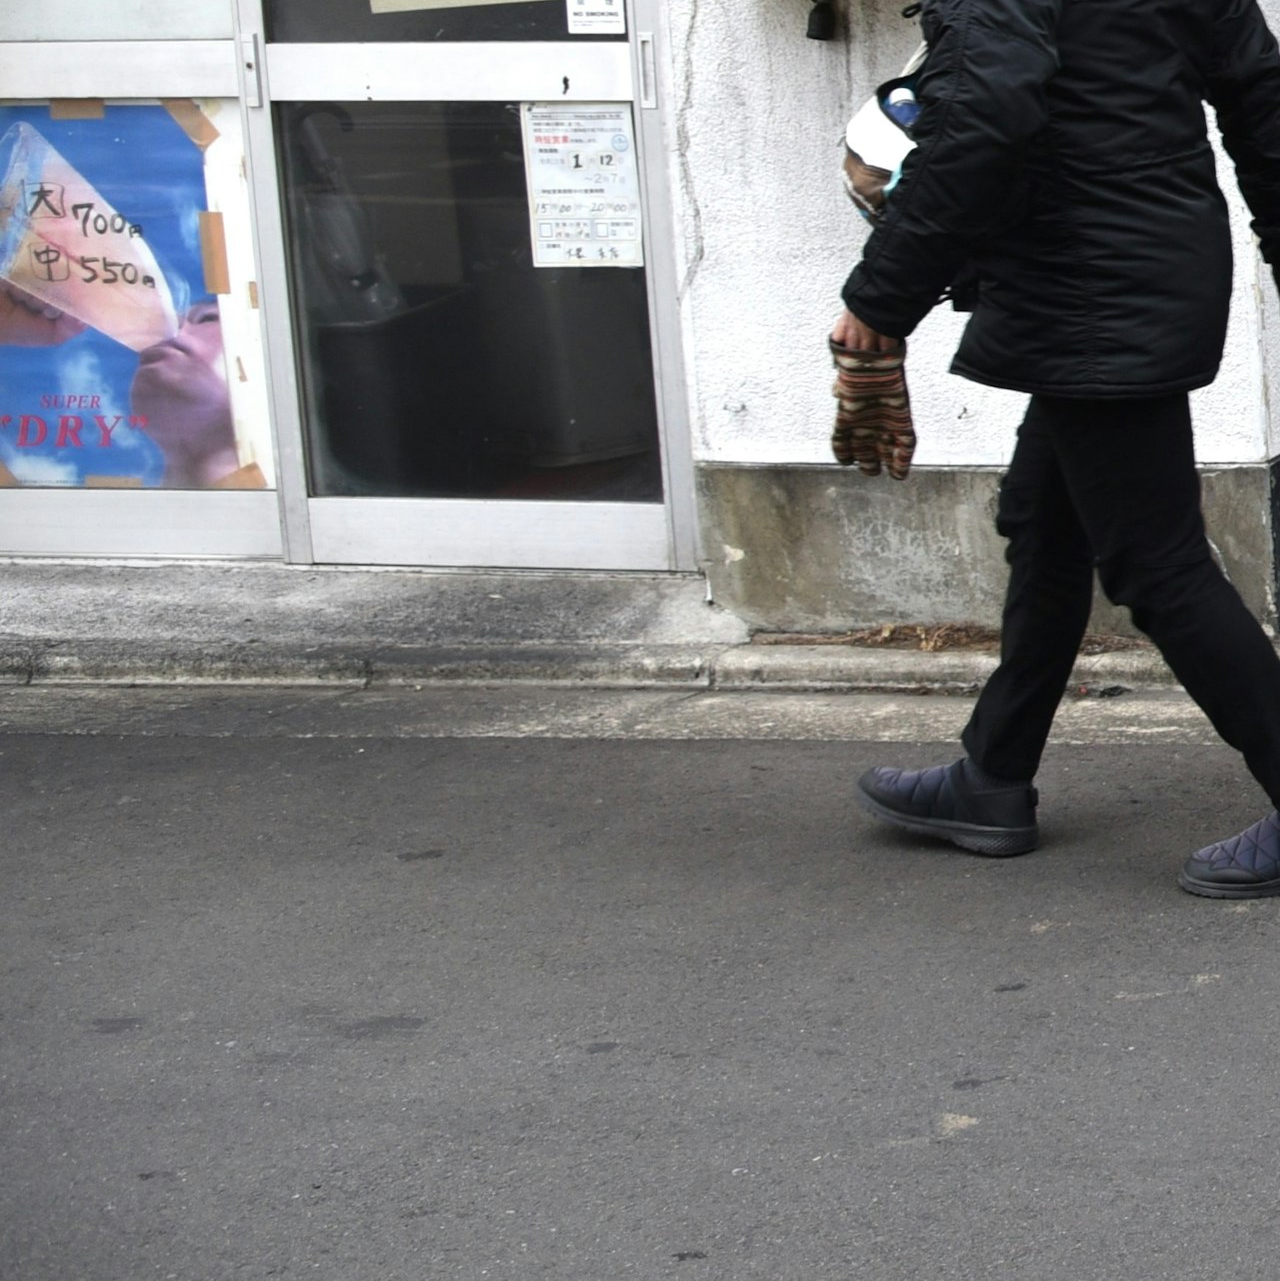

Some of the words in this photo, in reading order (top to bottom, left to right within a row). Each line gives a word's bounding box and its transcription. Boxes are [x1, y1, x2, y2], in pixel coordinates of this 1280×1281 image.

[30, 185, 61, 216] 大
[34, 244, 61, 282] 中
[40, 394, 103, 409] SUPER
